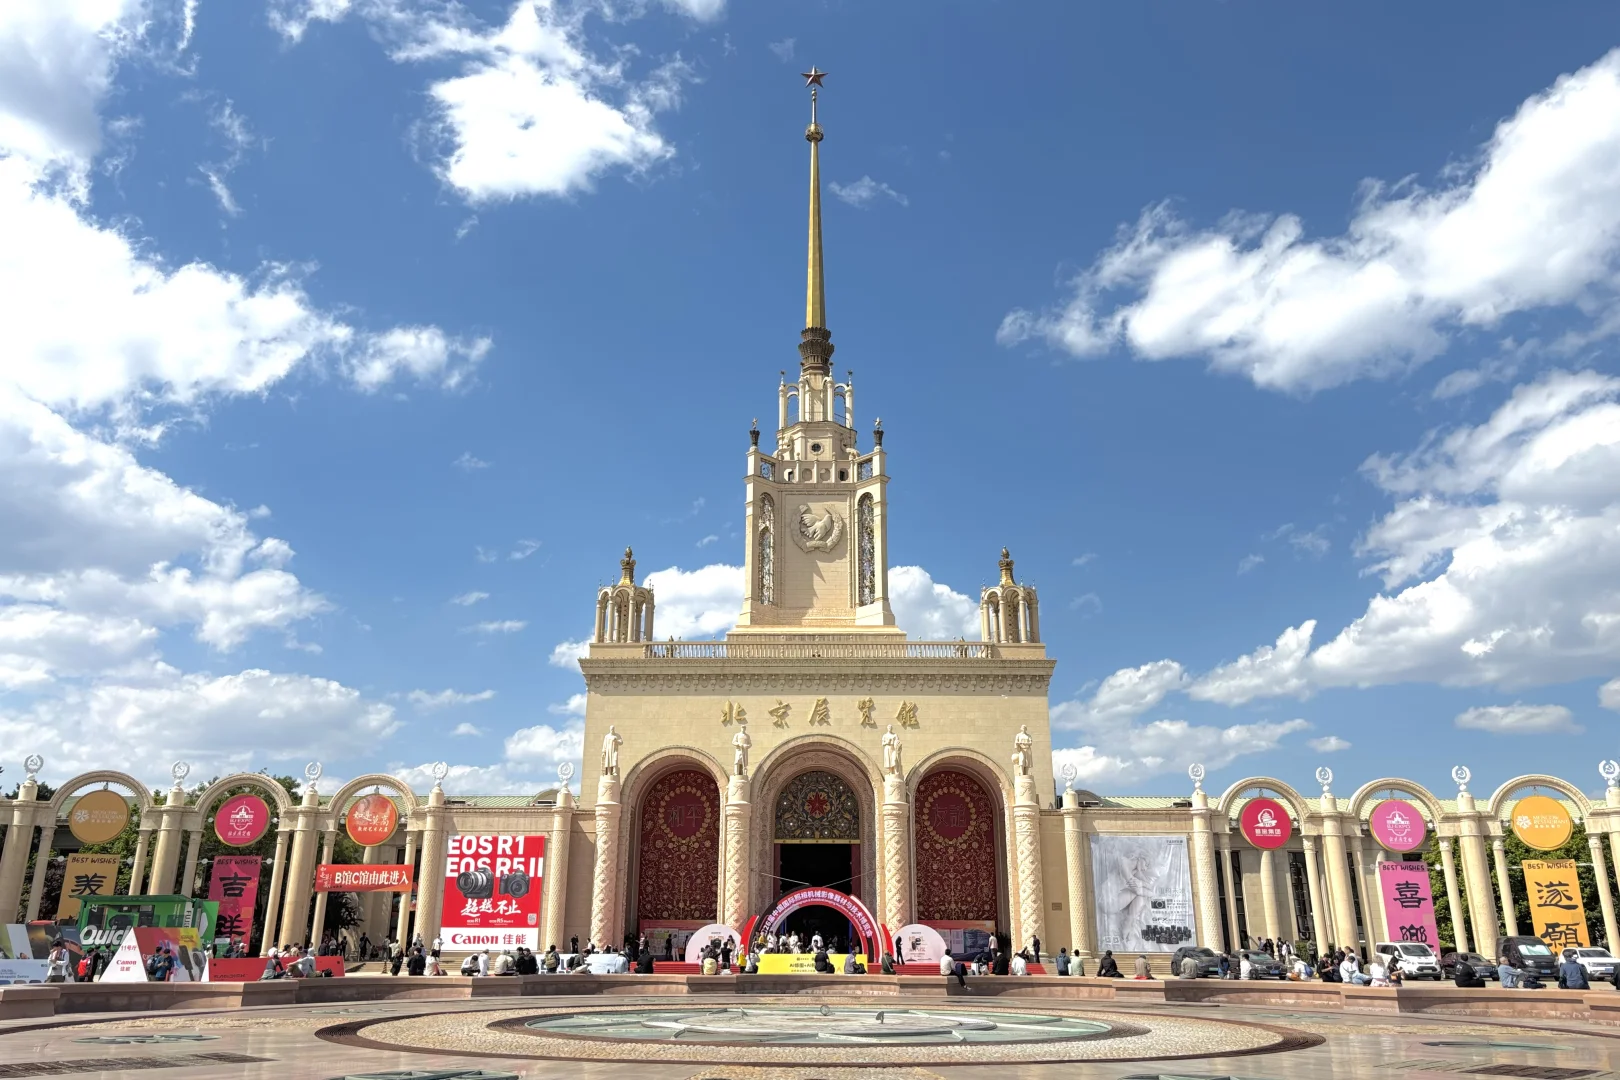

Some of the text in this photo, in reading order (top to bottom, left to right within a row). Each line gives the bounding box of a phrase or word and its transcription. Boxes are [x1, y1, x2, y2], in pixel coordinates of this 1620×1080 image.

[667, 804, 702, 827] 和平
[447, 835, 525, 855] EOS R1
[445, 857, 492, 877] EOS
[495, 857, 525, 877] R5
[334, 870, 408, 885] B馆C馆由此进入
[461, 898, 521, 917] 超越不止
[451, 933, 526, 944] Canon 佳能
